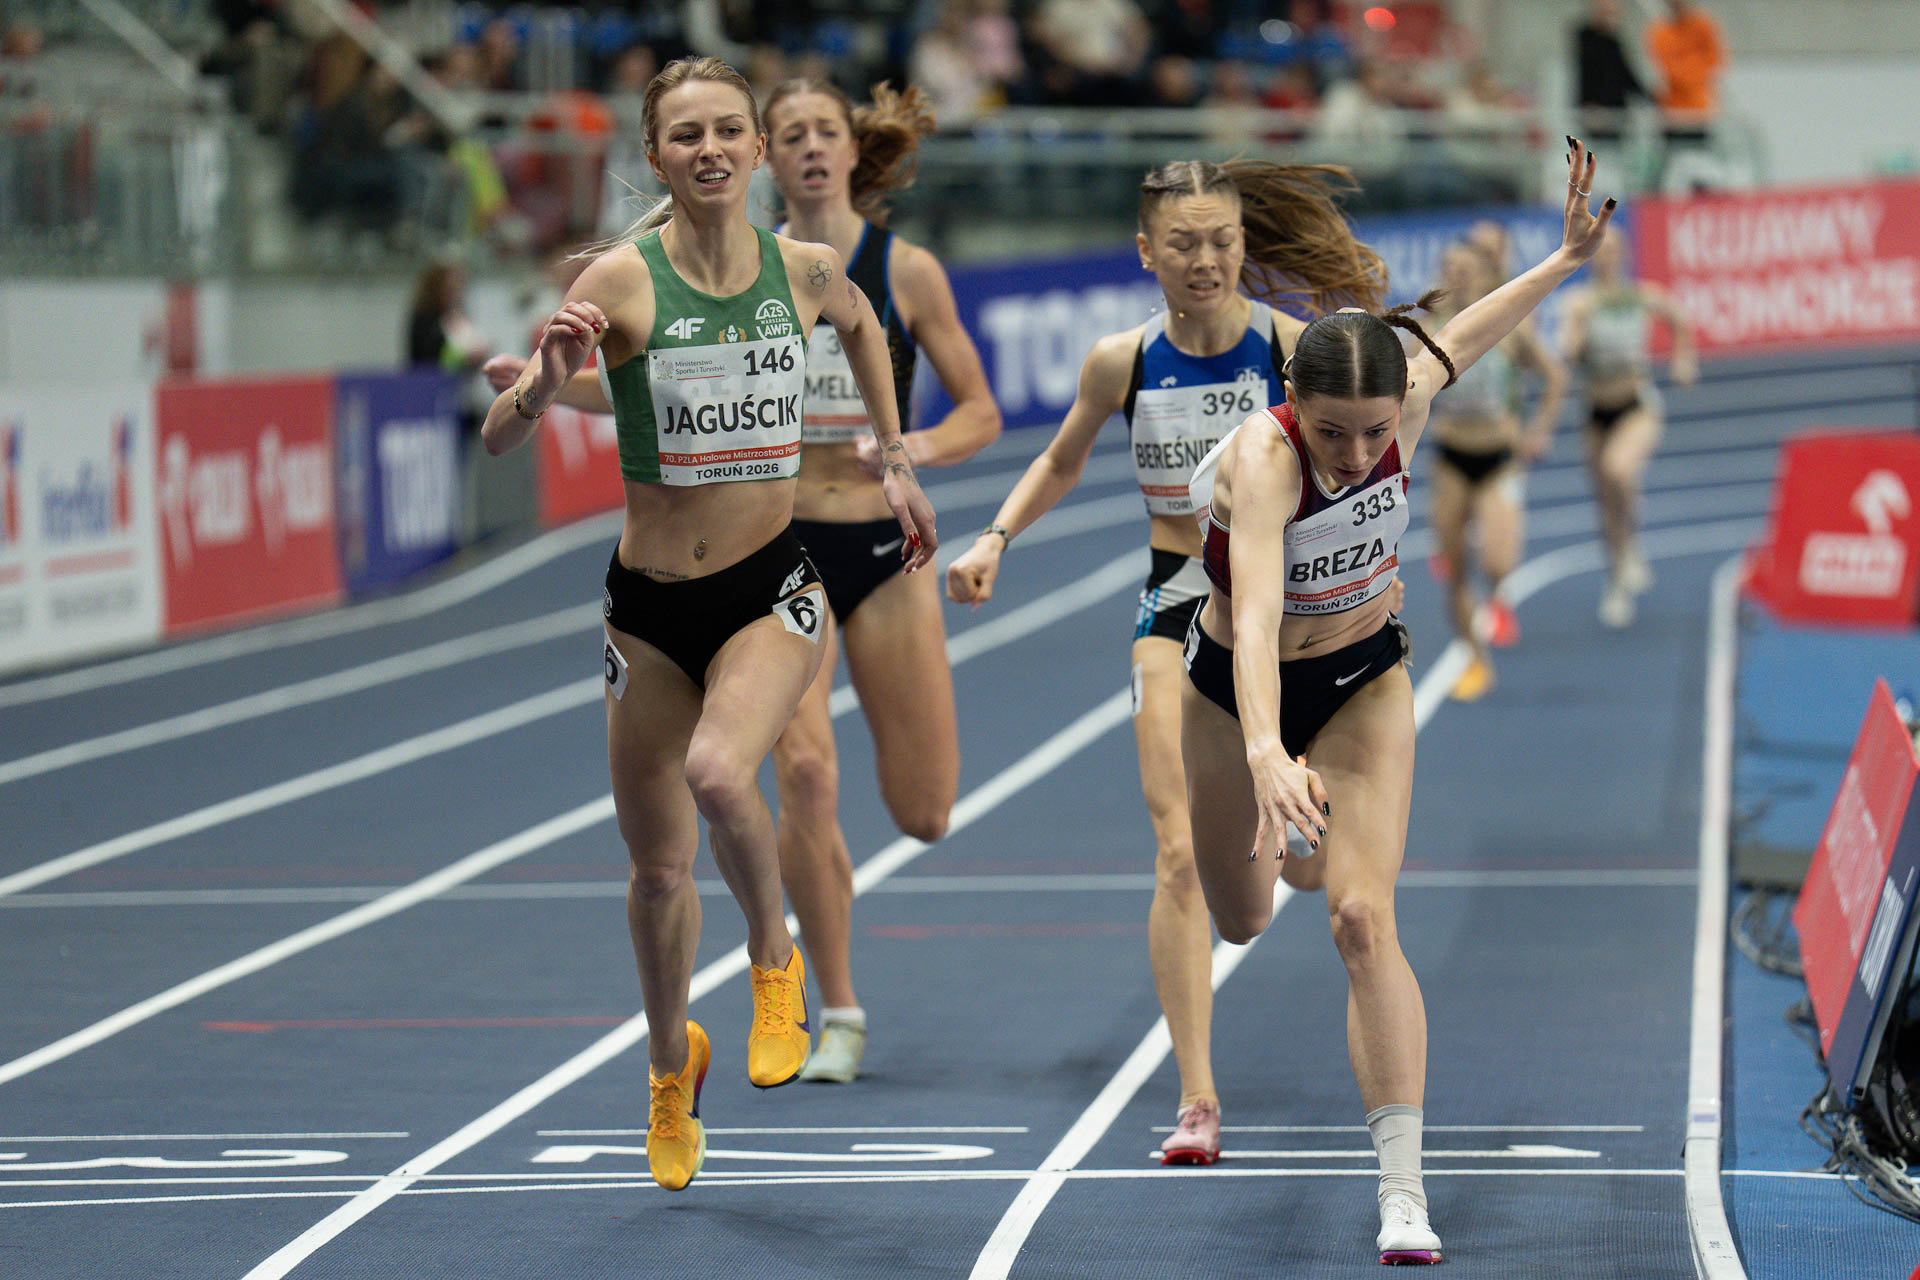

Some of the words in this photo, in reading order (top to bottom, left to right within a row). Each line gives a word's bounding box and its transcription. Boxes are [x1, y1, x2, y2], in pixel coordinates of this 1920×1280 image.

[760, 317, 789, 325] WARSZAWA
[762, 306, 784, 319] AZS
[664, 317, 706, 339] 4F
[764, 323, 791, 337] AWF
[675, 359, 713, 368] Ministerstwo
[743, 345, 795, 376] 146
[675, 367, 696, 376] Sportu
[1202, 390, 1254, 416] 396
[663, 393, 799, 436] JAGUŚCIK
[678, 454, 698, 464] PZLA
[699, 452, 732, 463] Halowe
[733, 447, 784, 459] Mistrzostwa
[1135, 435, 1220, 469] BEREŚNIE
[695, 463, 743, 480] TORUŃ
[746, 463, 780, 476] 2026
[1167, 500, 1194, 511] TOR
[1351, 486, 1396, 527] 333
[1288, 537, 1385, 583] BREZA
[778, 562, 806, 598] 4F
[1293, 598, 1340, 611] TORUŃ
[787, 596, 817, 635] 6
